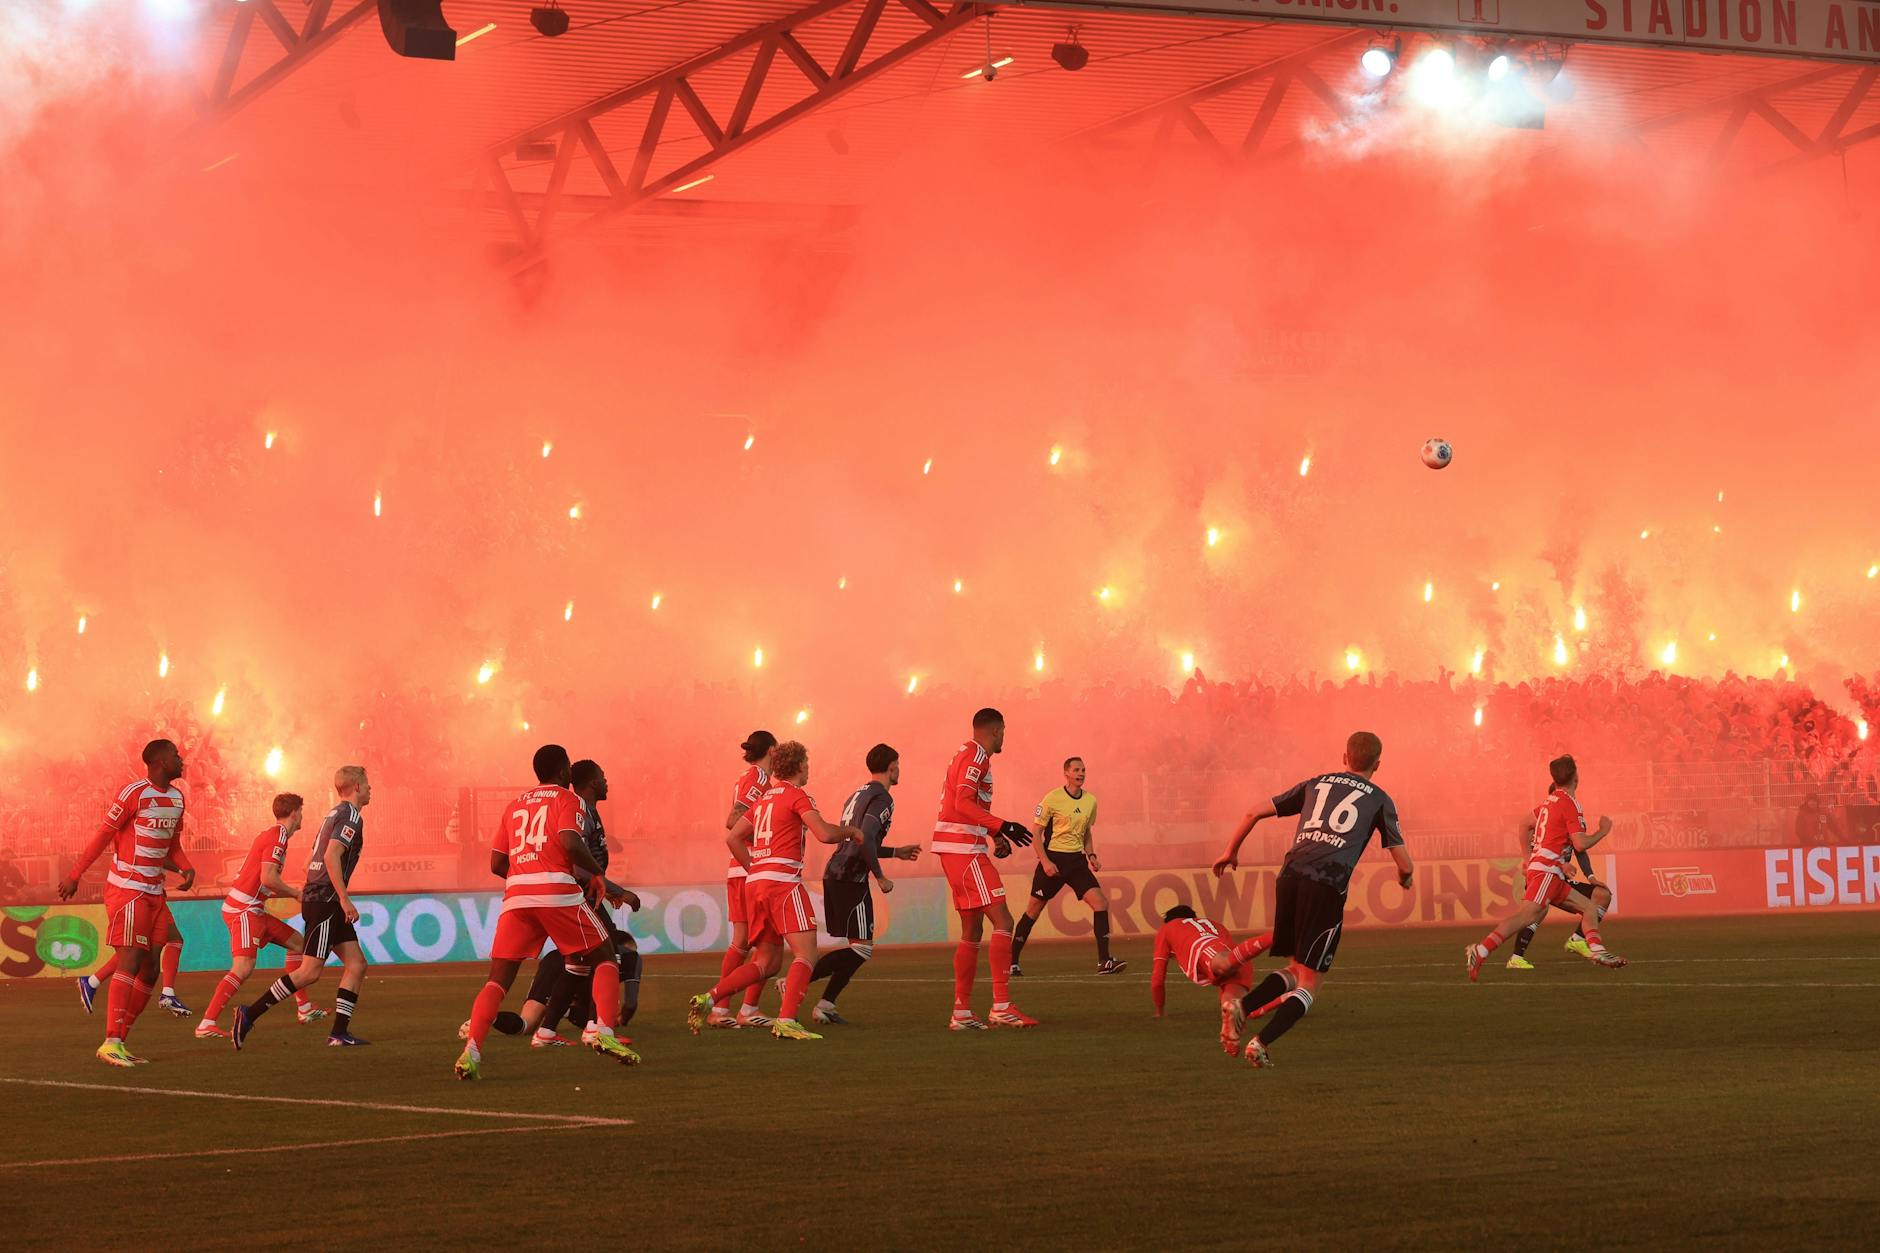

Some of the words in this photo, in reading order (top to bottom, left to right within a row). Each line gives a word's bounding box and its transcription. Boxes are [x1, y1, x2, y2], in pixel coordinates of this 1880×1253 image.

[1586, 0, 1797, 45] STADION
[533, 790, 558, 798] UNION
[1320, 776, 1373, 794] LARSSON
[753, 803, 773, 847] 14
[1303, 782, 1365, 833] 16
[510, 805, 548, 856] 34
[363, 860, 436, 873] MOMME
[1764, 845, 1880, 908] EISER
[1181, 917, 1219, 936] 11
